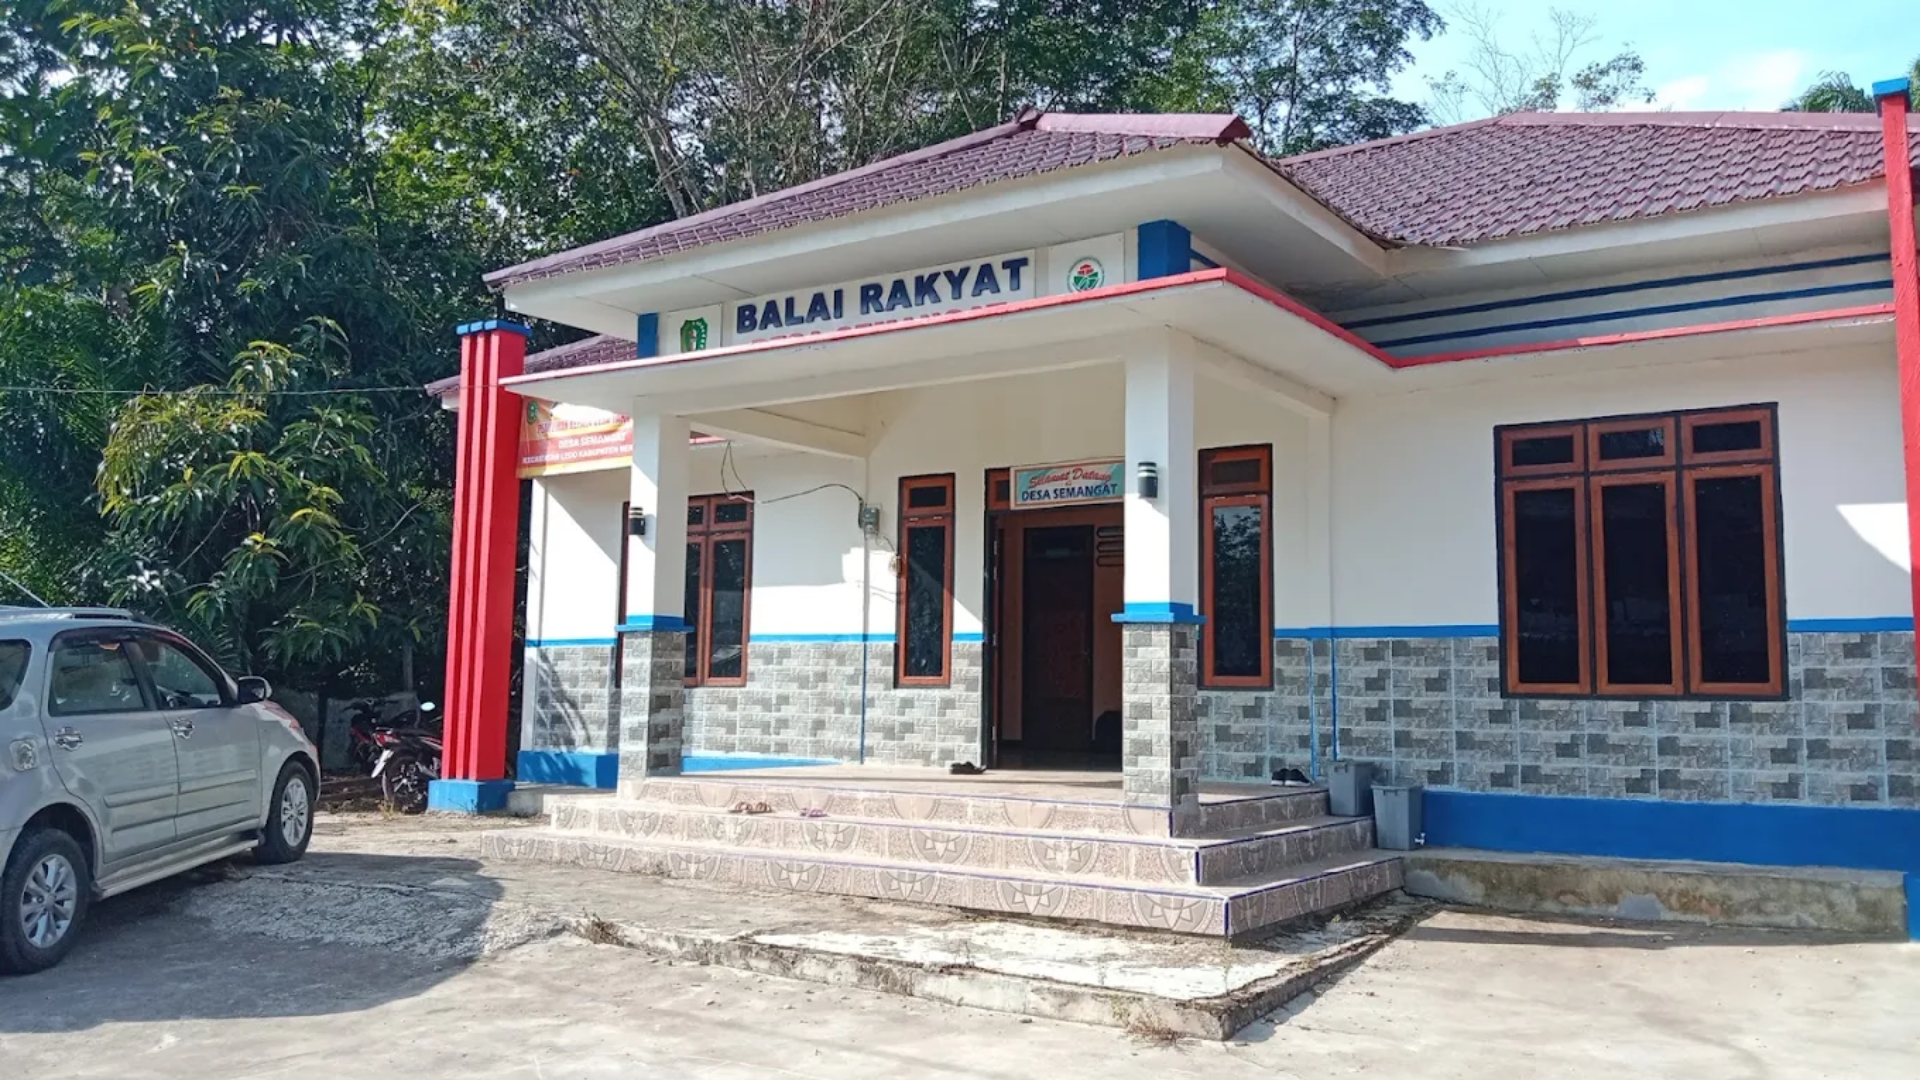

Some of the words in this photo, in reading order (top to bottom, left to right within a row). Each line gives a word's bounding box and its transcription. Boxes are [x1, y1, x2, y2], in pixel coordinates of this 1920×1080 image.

[736, 288, 844, 334] BALAI
[860, 257, 1029, 316] RAKYAT
[1028, 470, 1070, 488] Selamat
[1072, 467, 1112, 484] Datang
[1021, 489, 1051, 501] DESA
[1053, 484, 1118, 499] SEMANGAT
